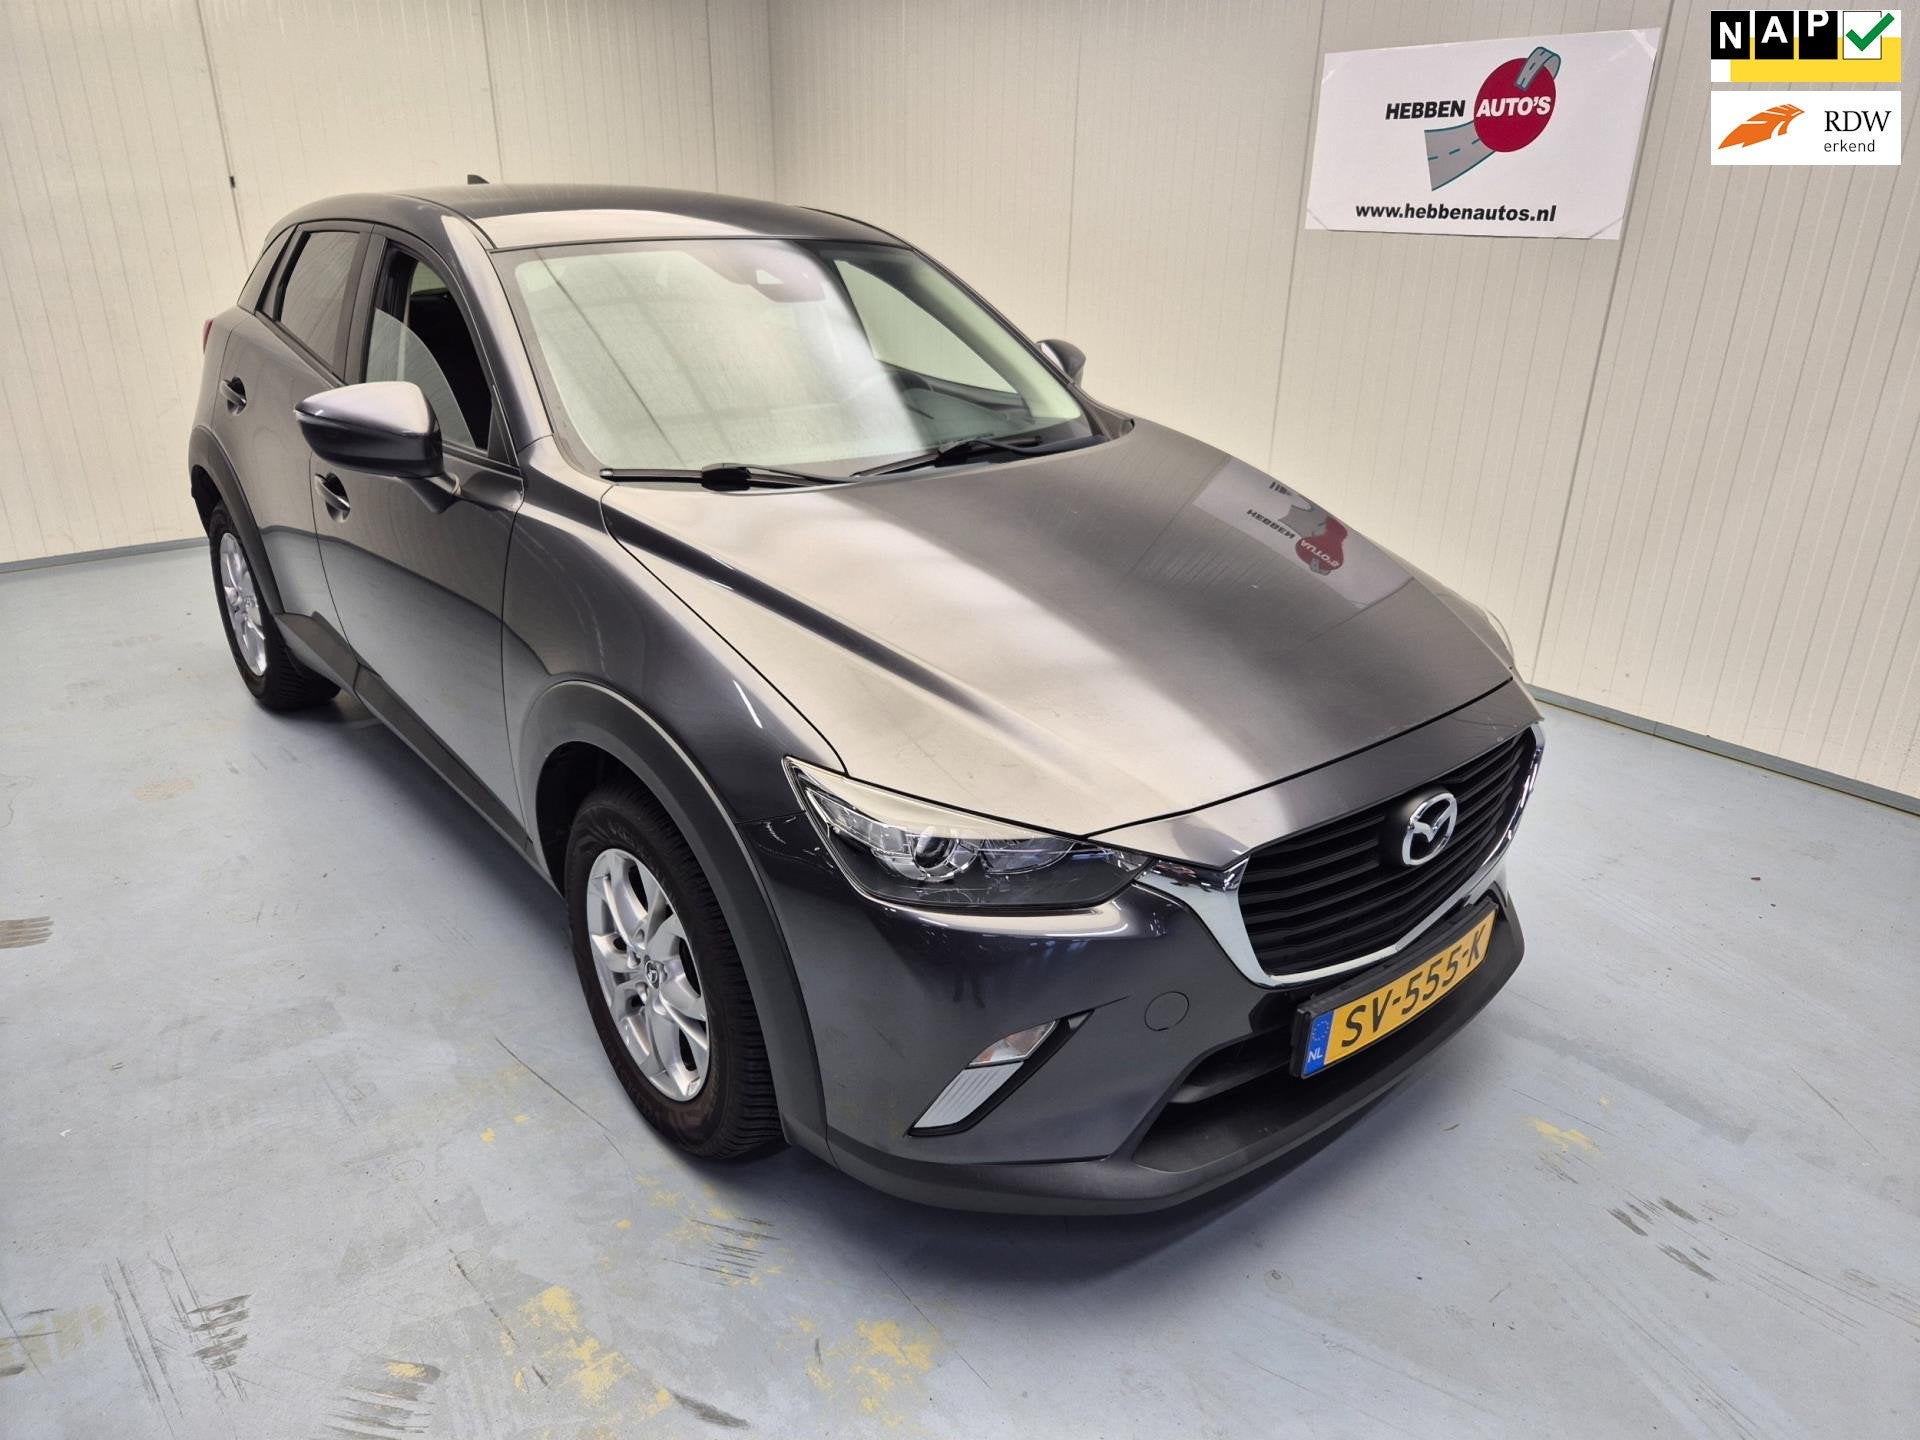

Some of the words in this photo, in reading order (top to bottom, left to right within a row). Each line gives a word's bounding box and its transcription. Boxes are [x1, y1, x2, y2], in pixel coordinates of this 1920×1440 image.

[1386, 100, 1465, 120] HEBBEN
[1476, 95, 1551, 118] AUTO'S
[1355, 203, 1556, 223] www.hebbenautos.nl
[1341, 926, 1484, 1048] SV-555-K
[1307, 1048, 1322, 1062] NL
